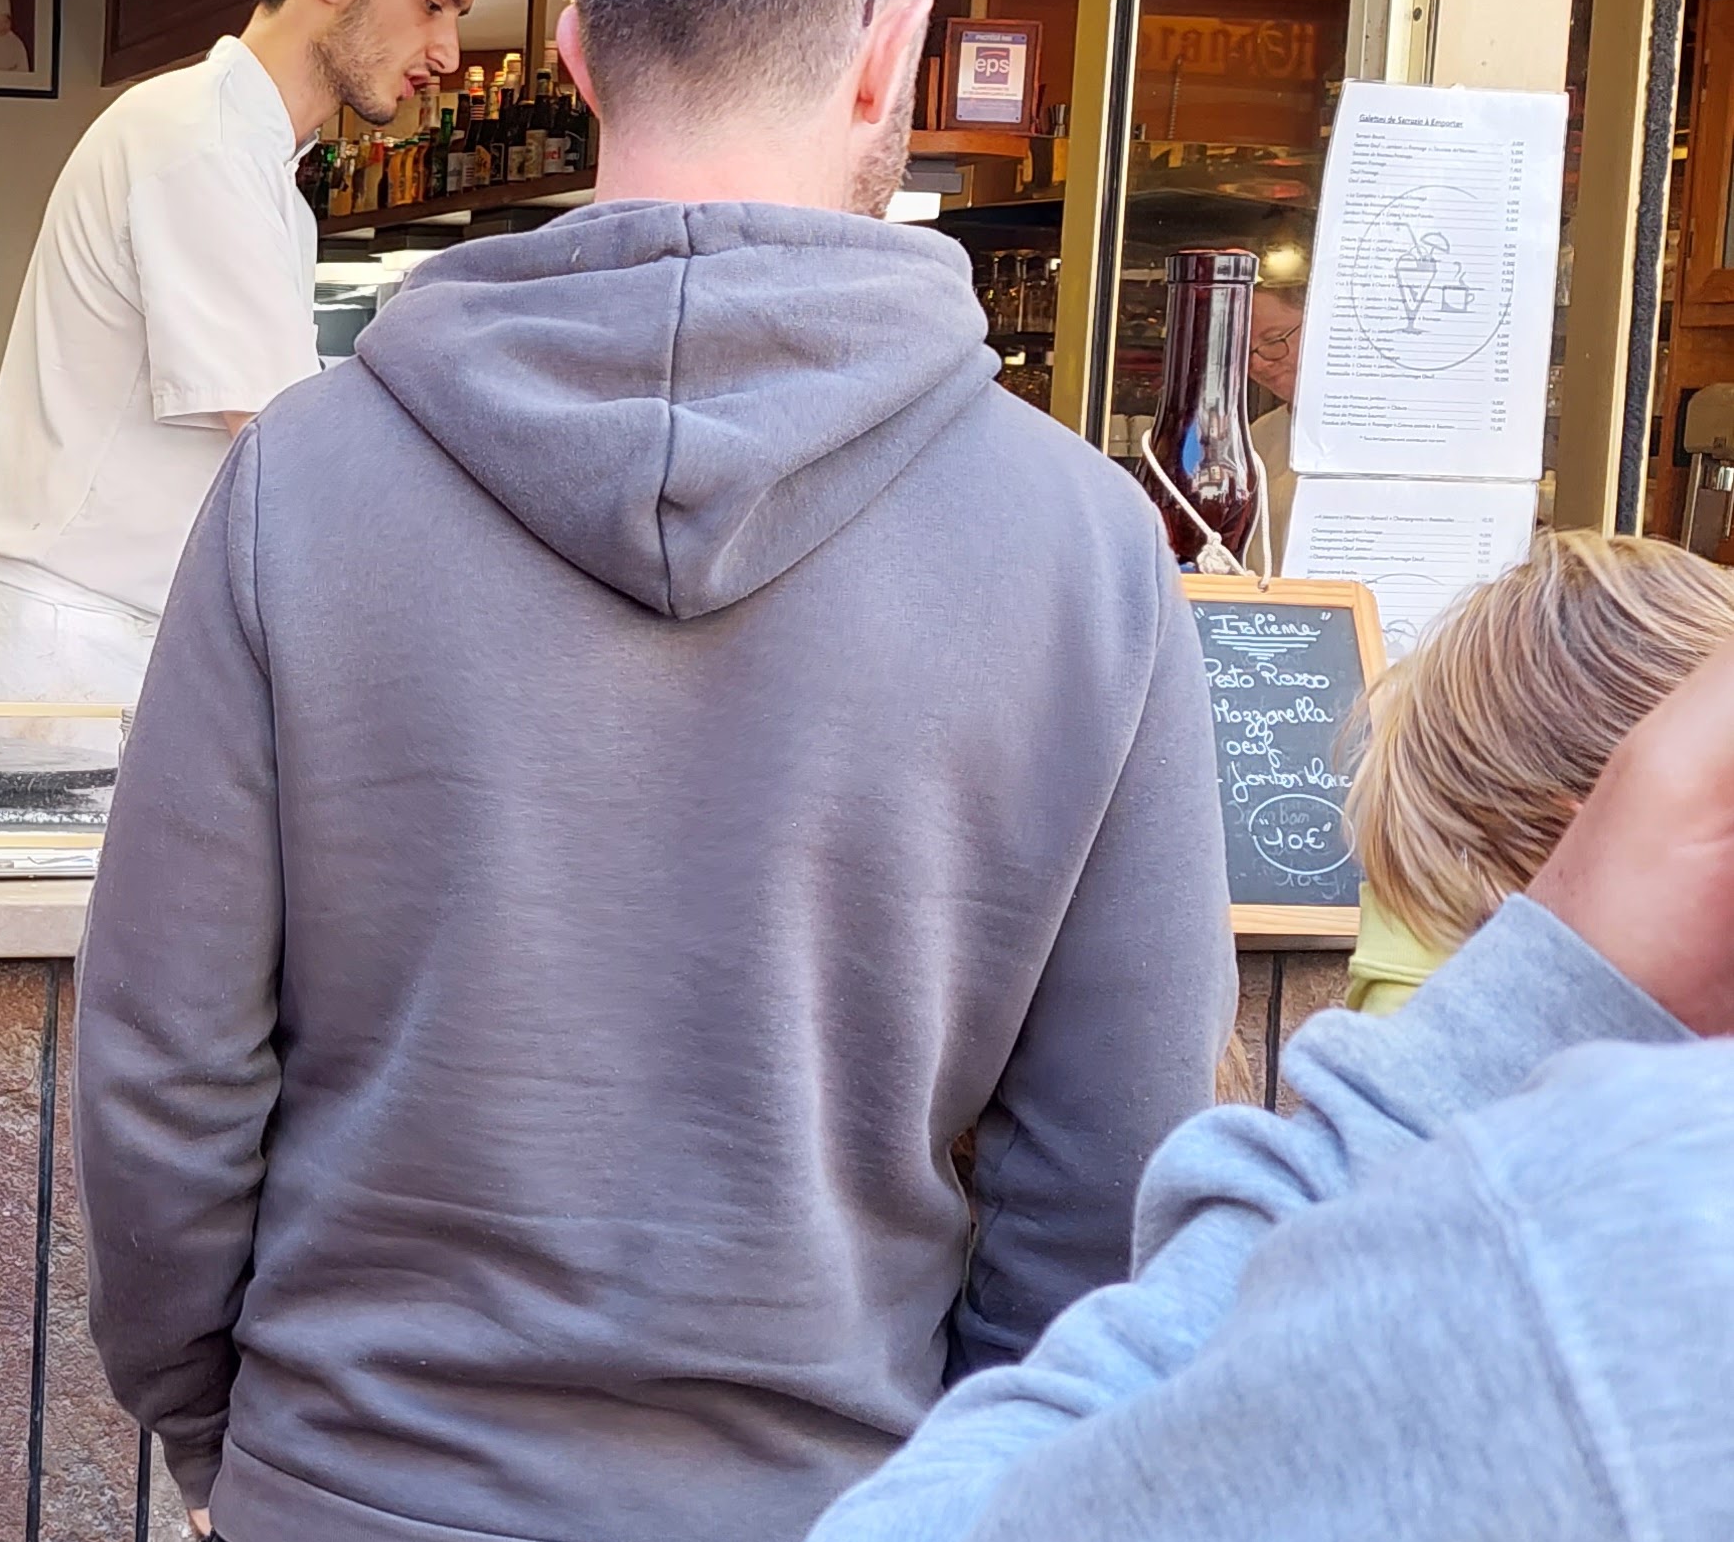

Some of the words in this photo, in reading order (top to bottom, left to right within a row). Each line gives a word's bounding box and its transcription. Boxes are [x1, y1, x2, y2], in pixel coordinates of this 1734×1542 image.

[974, 57, 1011, 77] eps
[1203, 658, 1255, 689] Pesto
[1231, 761, 1303, 803] Jambon
